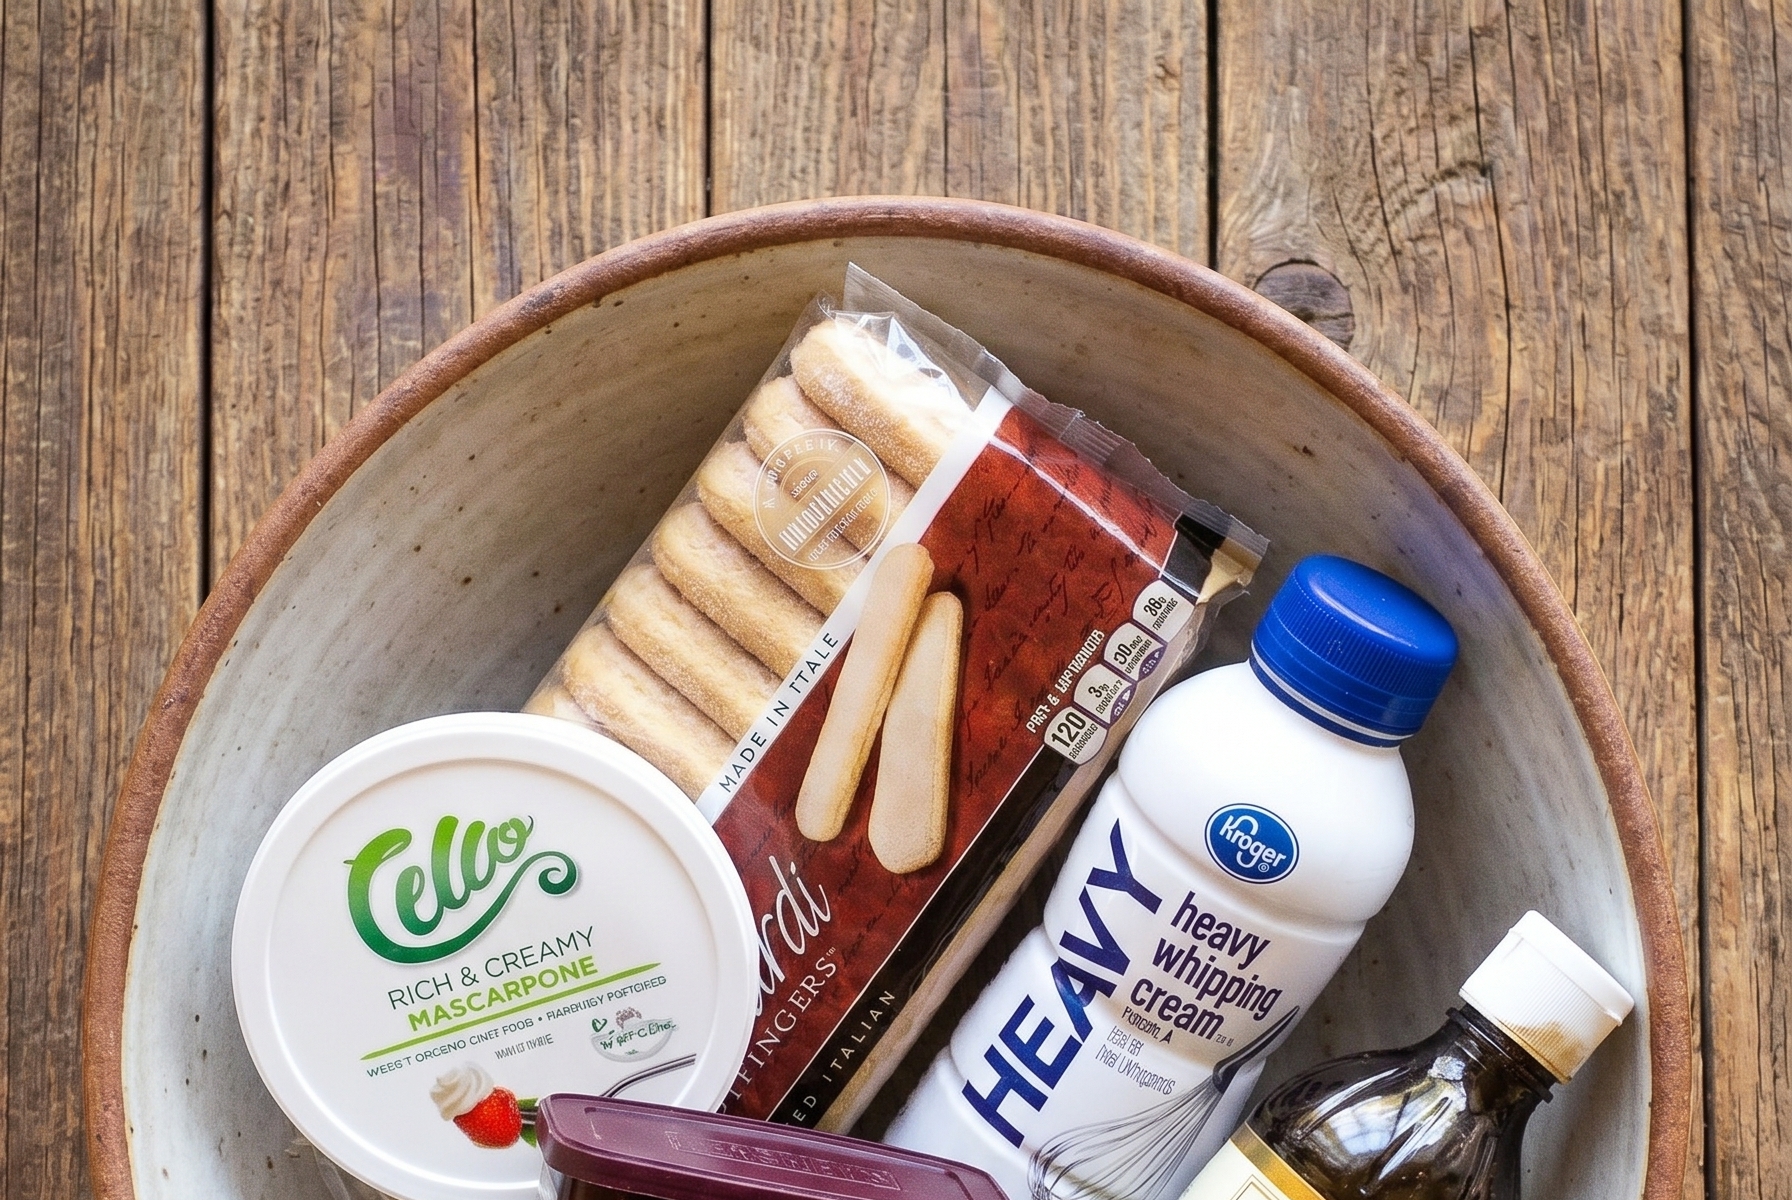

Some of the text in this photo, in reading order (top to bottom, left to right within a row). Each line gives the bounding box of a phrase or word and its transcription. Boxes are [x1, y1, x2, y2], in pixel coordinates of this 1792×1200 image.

[719, 734, 768, 793] MADE
[766, 700, 790, 728] IN
[1052, 711, 1087, 748] 120
[1219, 815, 1287, 869] Kroger
[388, 925, 595, 1010] RICH & CREAMY
[1170, 890, 1271, 971] heavy
[408, 956, 599, 1032] MASCARPONE
[962, 818, 1163, 1149] HEAVY
[1129, 978, 1226, 1041] cream
[1152, 937, 1284, 1021] whipping
[822, 990, 896, 1083] ITALIAN
